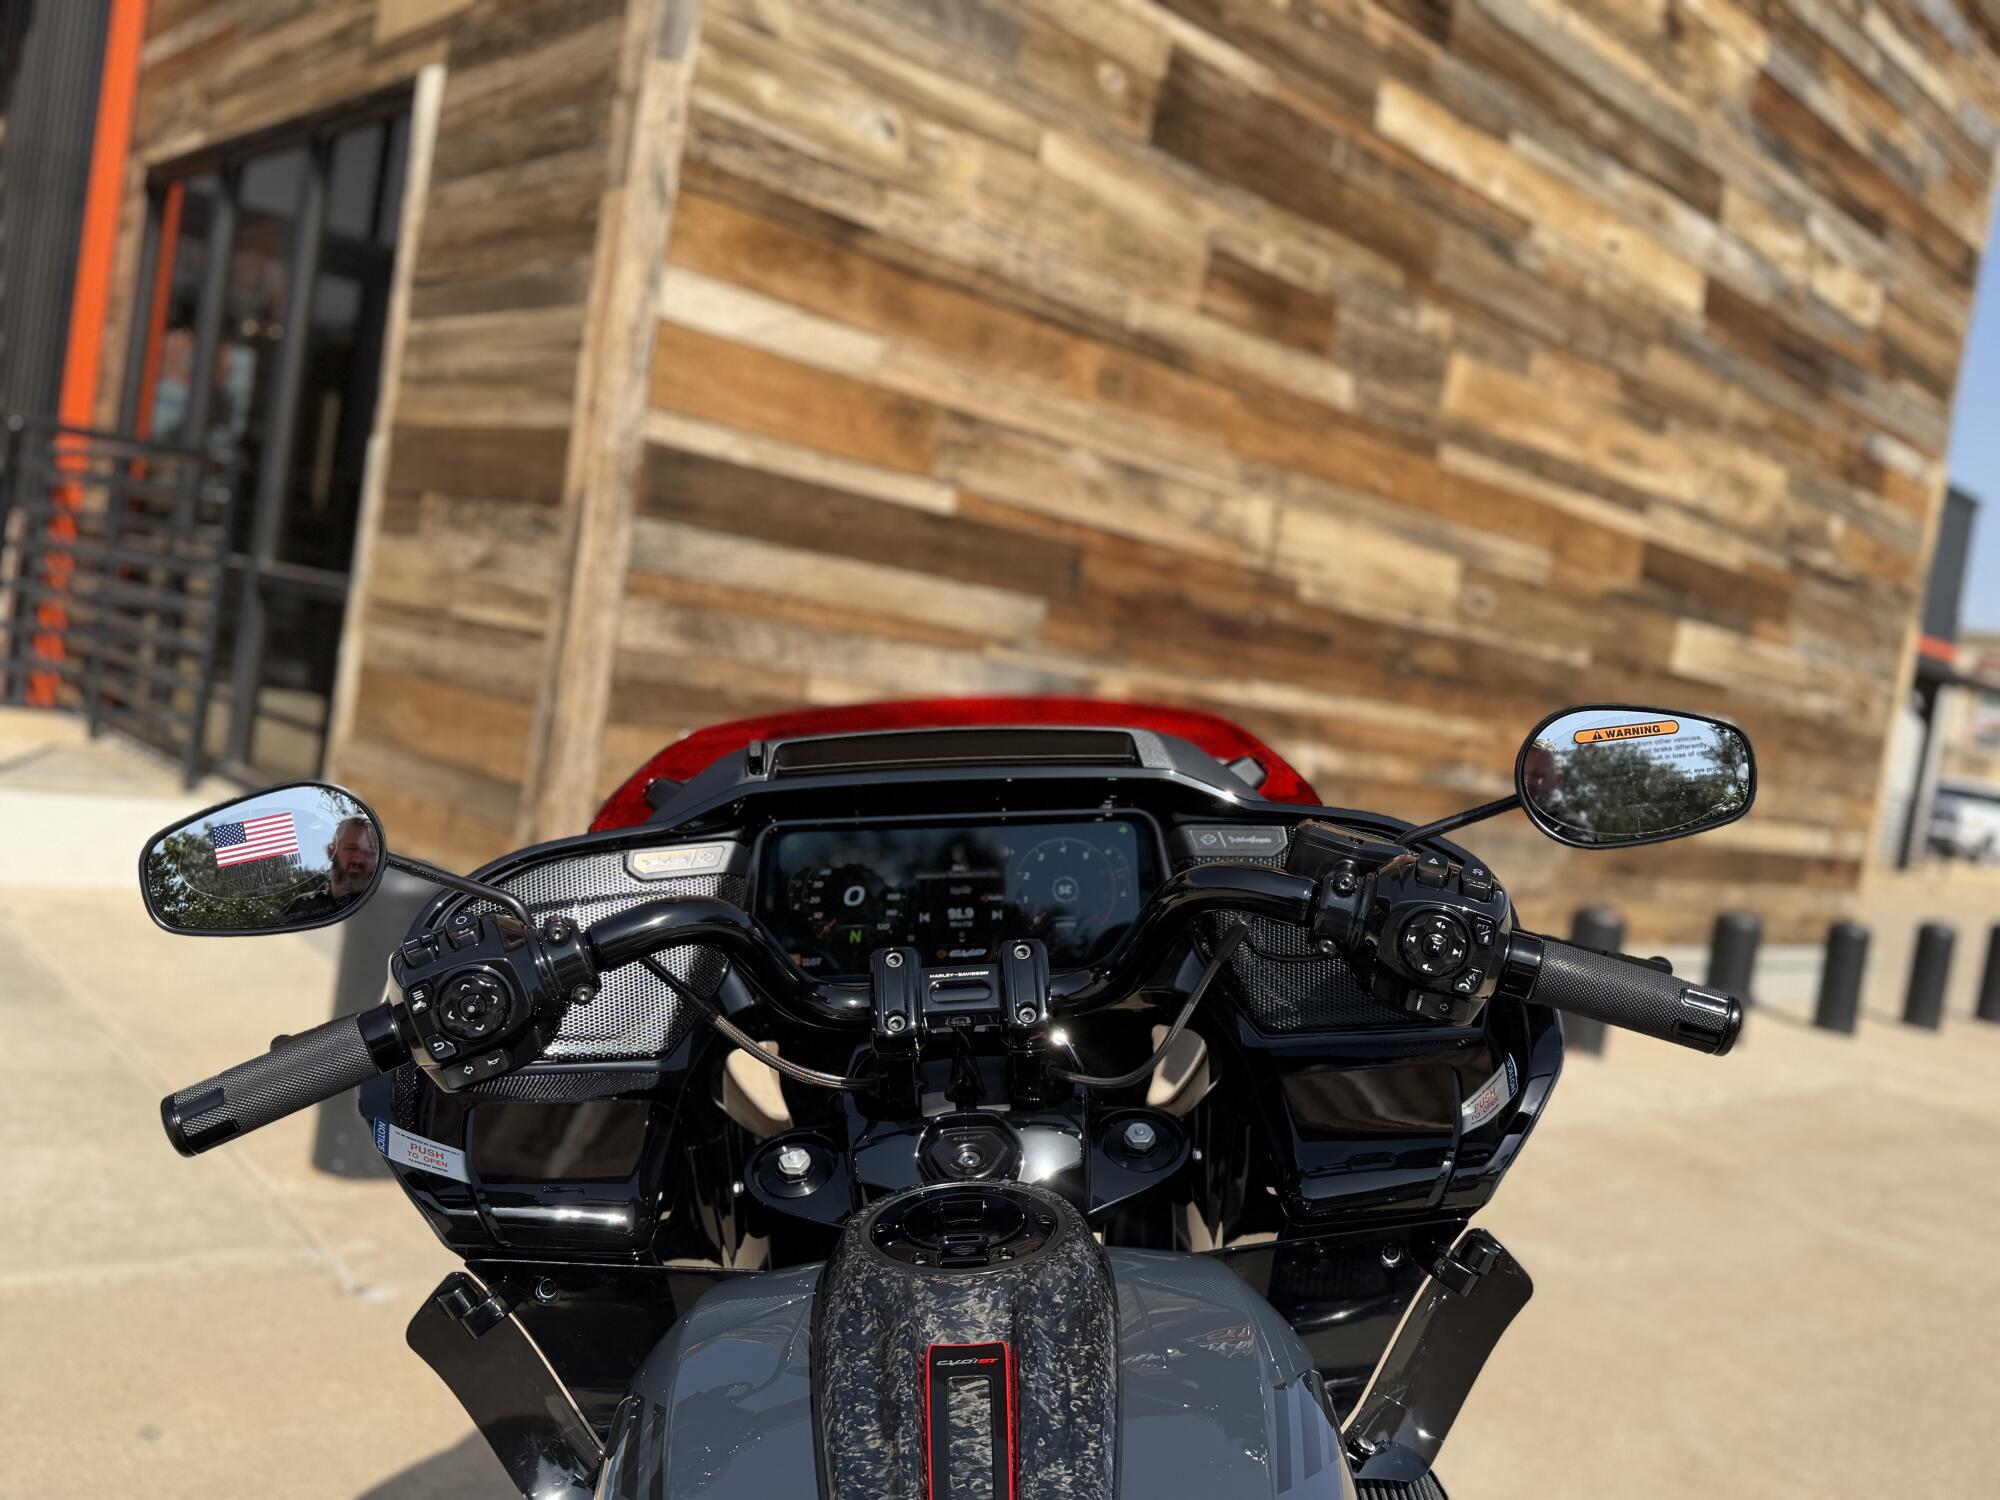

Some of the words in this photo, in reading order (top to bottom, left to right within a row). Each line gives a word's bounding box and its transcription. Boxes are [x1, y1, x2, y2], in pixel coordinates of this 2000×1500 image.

[1605, 724, 1661, 739] WARNING
[849, 929, 863, 944] N
[929, 970, 990, 979] HARLEY-DAVIDSON
[1473, 1087, 1496, 1113] PUSH
[378, 1120, 386, 1153] NOTICE
[407, 1151, 419, 1160] TO
[423, 1156, 448, 1168] OPEN
[410, 1142, 445, 1160] PUSH
